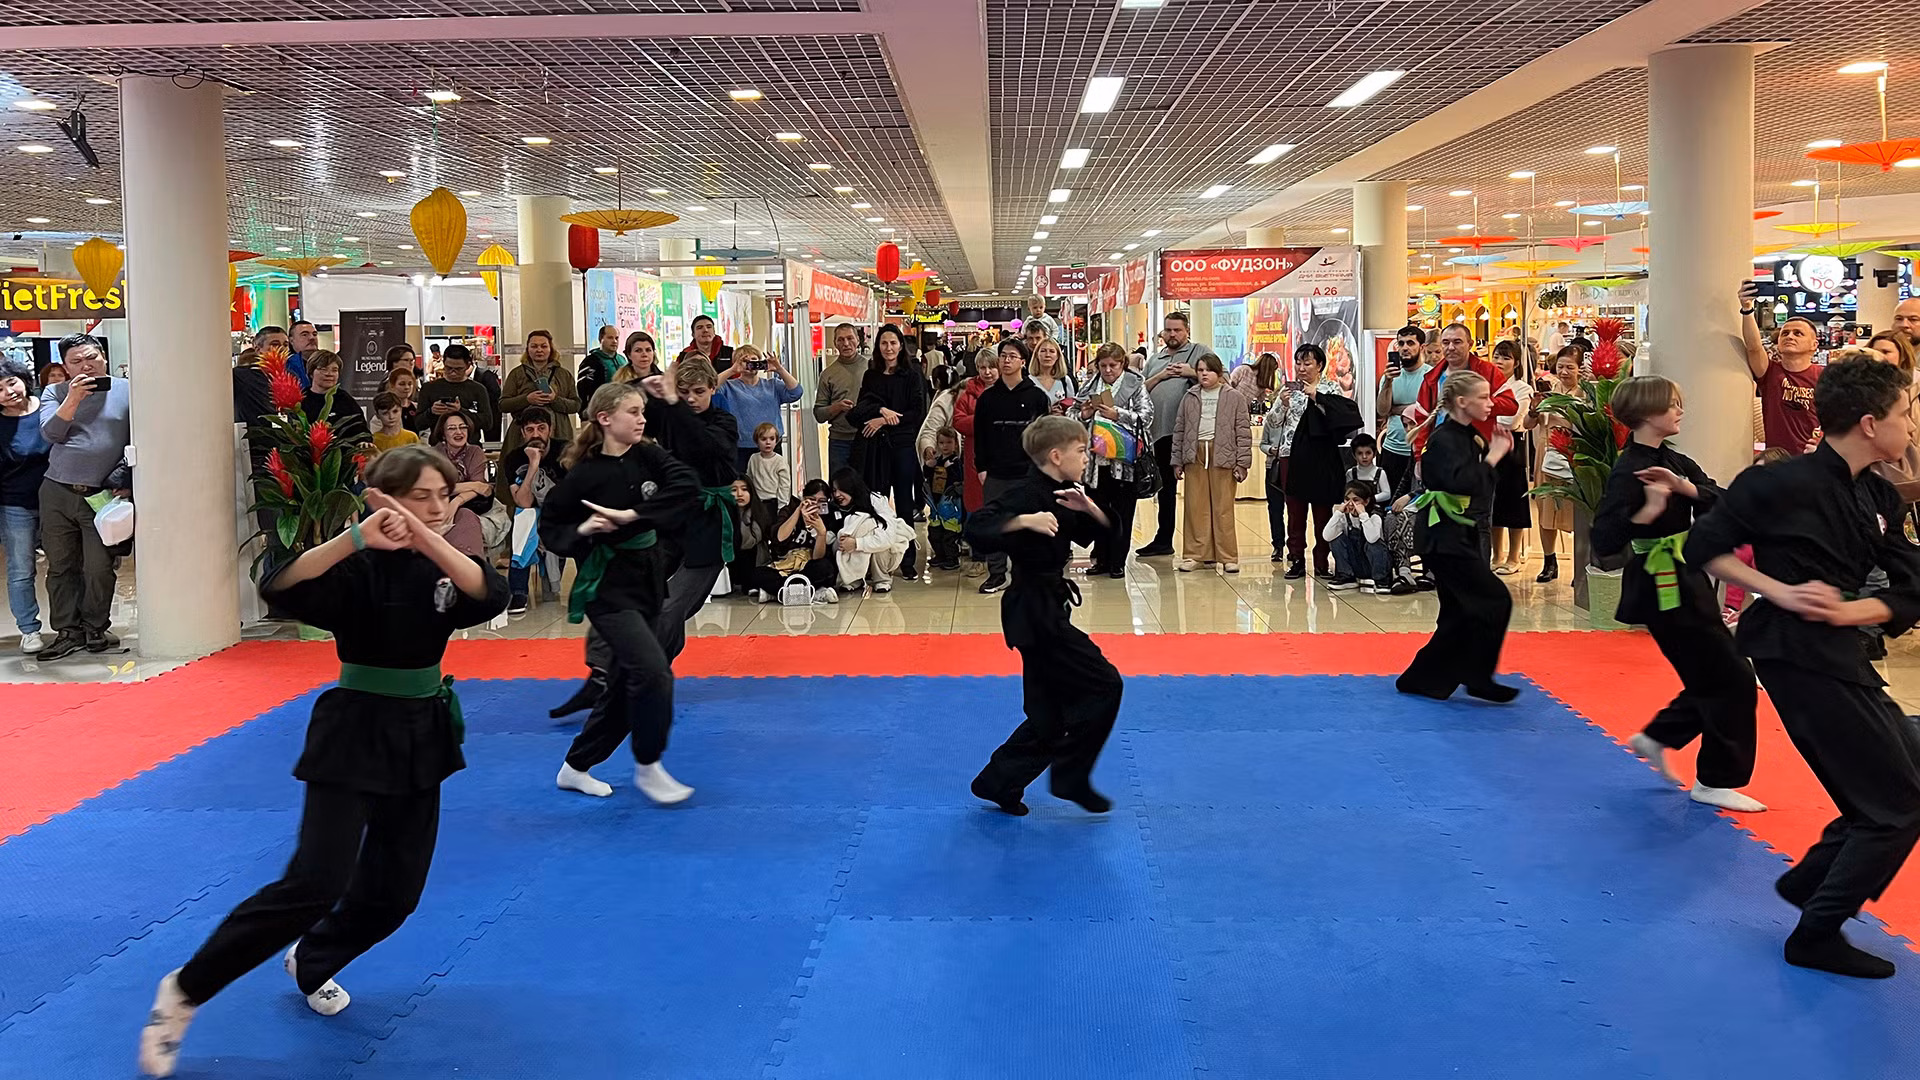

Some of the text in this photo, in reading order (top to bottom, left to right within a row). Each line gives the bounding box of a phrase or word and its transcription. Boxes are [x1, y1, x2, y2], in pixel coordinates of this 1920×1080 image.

[1170, 257, 1294, 273] ООО «ФУДЗОН»
[0, 280, 127, 311] ietFres
[1324, 286, 1338, 296] 26
[355, 360, 387, 374] Legend
